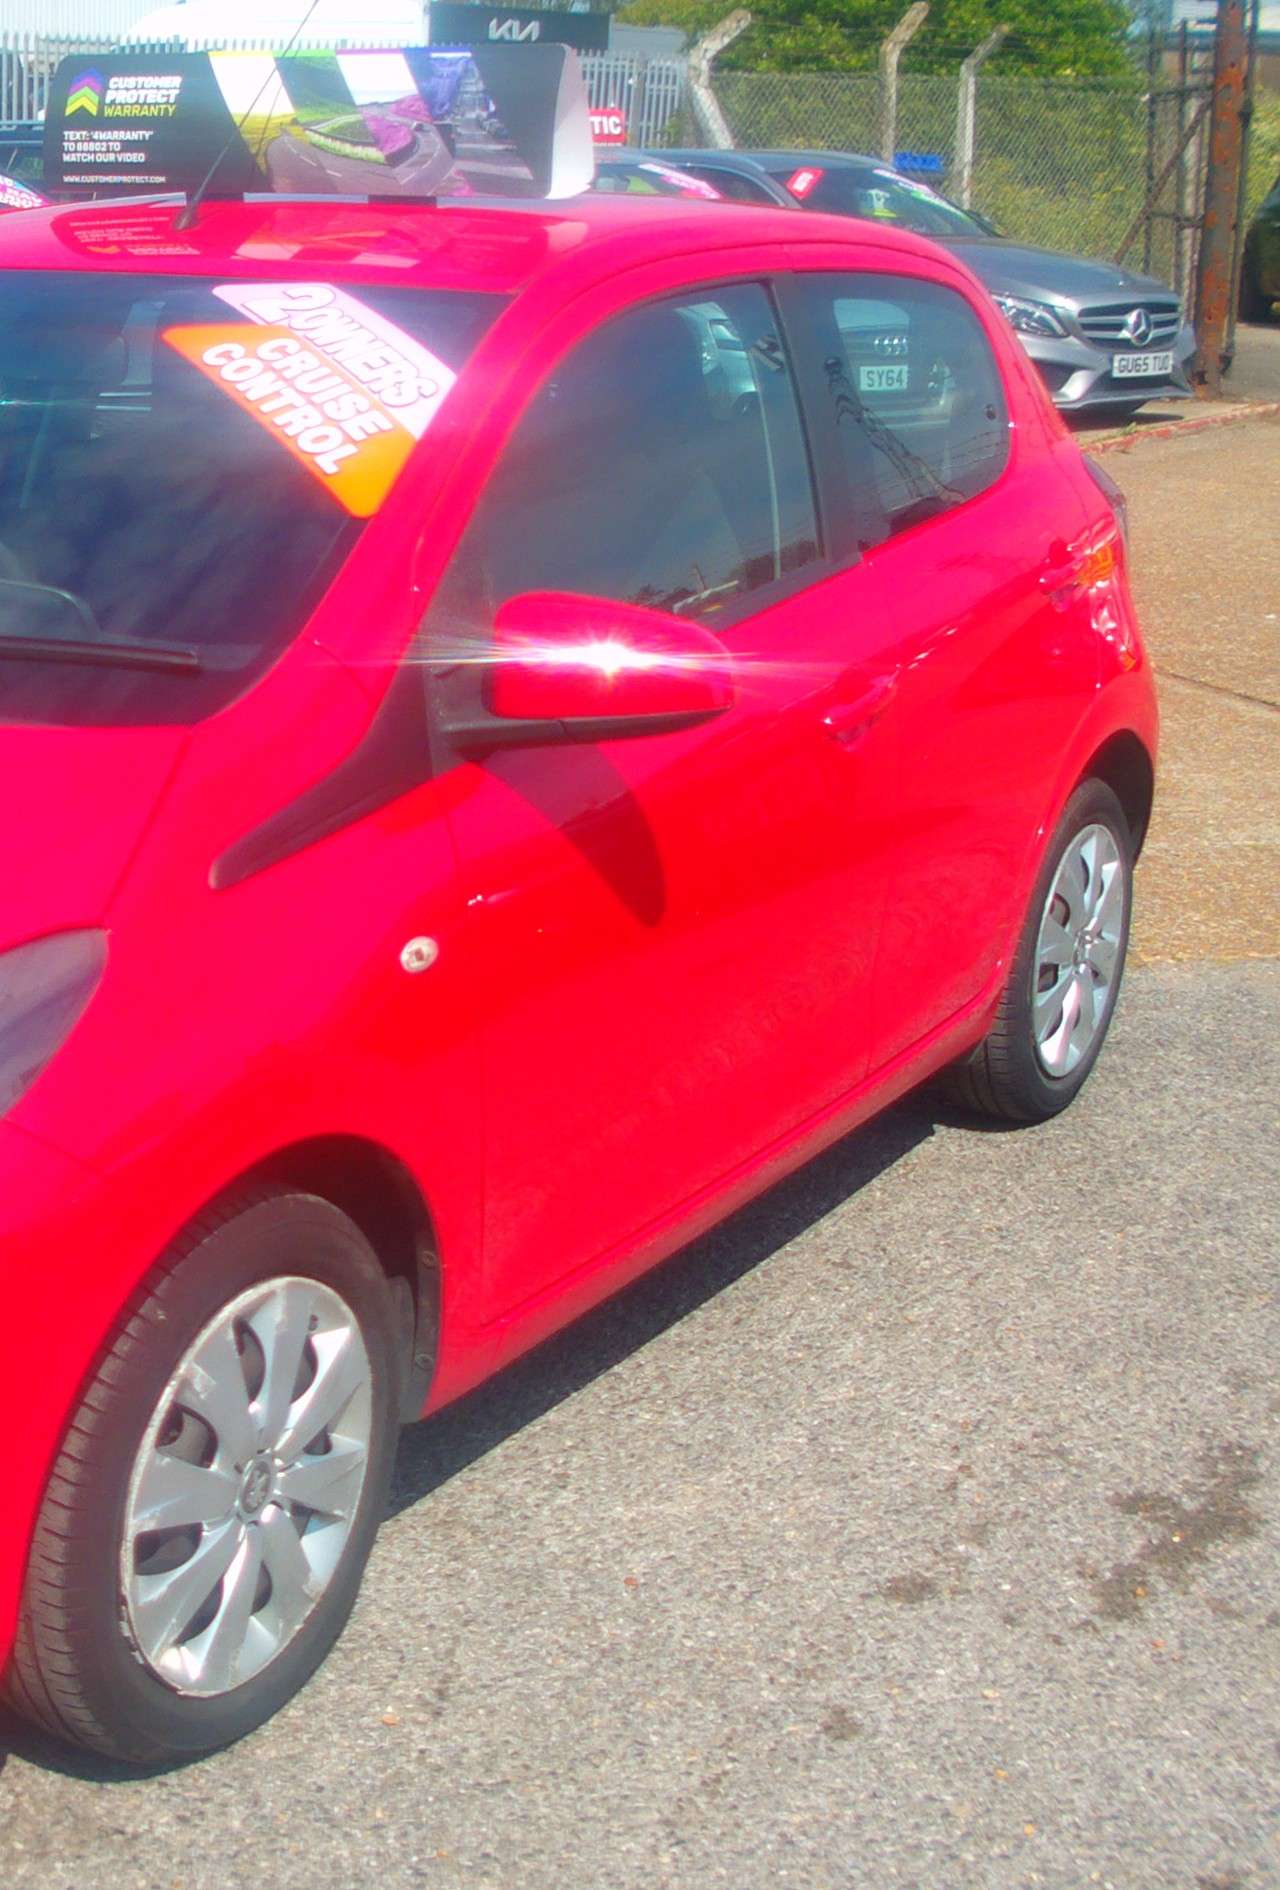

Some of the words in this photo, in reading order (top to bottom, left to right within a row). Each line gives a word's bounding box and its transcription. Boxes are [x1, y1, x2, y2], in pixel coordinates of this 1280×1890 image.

[488, 16, 540, 41] KIA
[109, 75, 182, 89] CUSTOMER
[105, 89, 180, 104] PROTECT
[104, 105, 176, 117] WARRANTY
[63, 142, 75, 151] TO
[109, 142, 121, 151] TO
[96, 153, 115, 162] OUR
[116, 153, 145, 162] VIDEO
[288, 307, 439, 408] OWNERS
[256, 338, 393, 442] CRUISE
[201, 343, 359, 475] CONTROL
